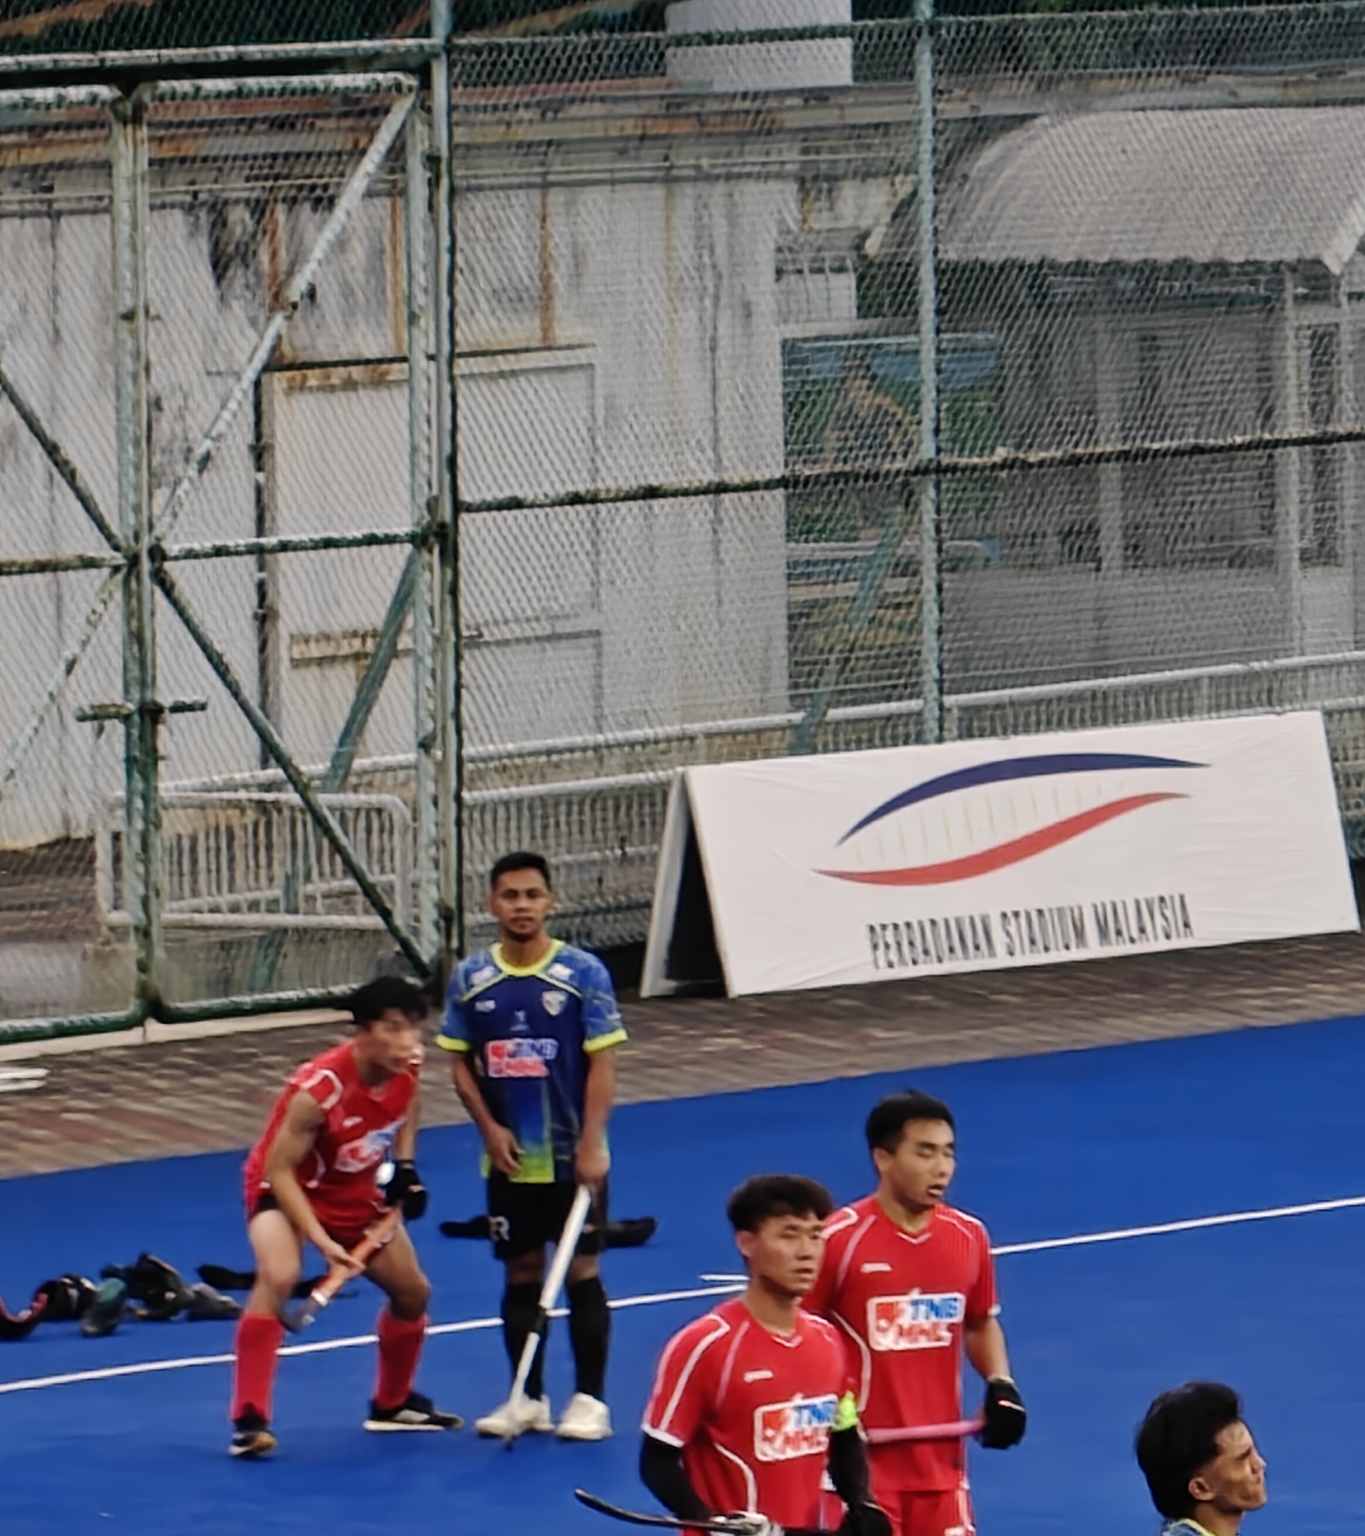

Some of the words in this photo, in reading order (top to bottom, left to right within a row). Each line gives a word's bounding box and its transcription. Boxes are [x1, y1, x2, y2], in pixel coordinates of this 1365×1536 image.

[866, 912, 997, 970] PERBADANAN
[1000, 903, 1089, 957] STADIUM
[1092, 893, 1194, 947] MALAYSIA
